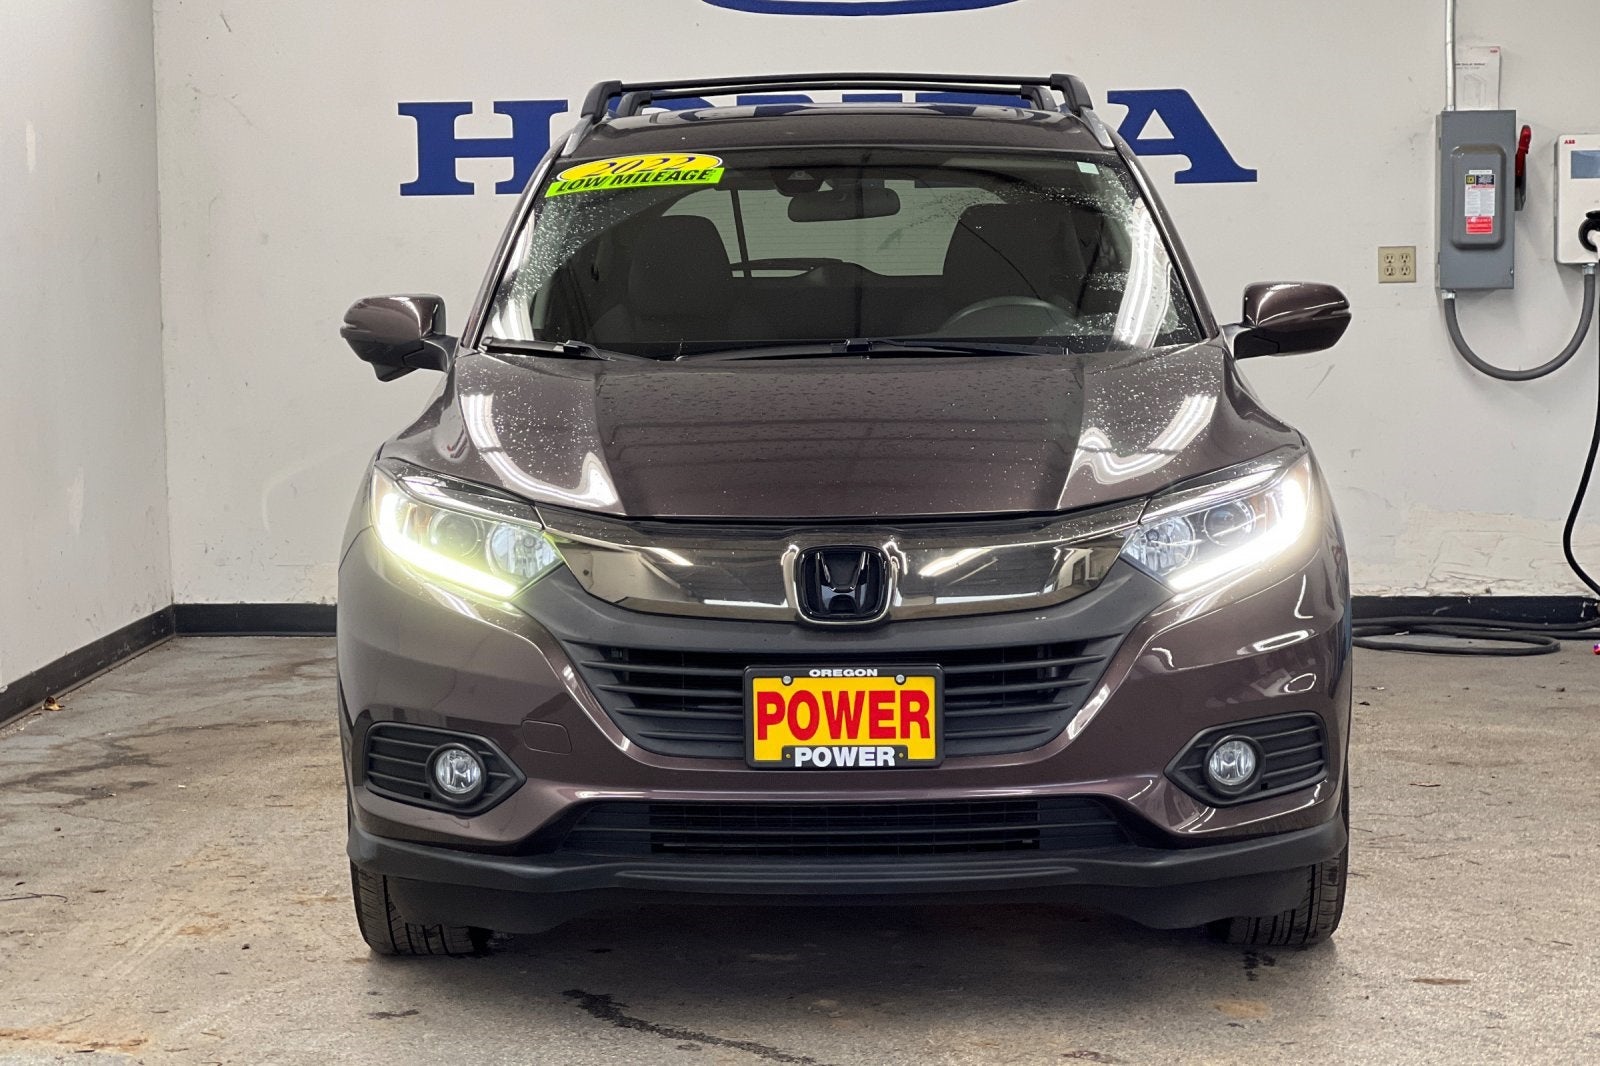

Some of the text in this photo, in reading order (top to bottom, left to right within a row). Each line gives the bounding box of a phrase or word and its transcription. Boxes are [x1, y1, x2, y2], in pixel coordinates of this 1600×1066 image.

[581, 156, 695, 178] 2022
[557, 169, 713, 192] LOW MILEAGE
[808, 668, 878, 678] OREGON
[756, 690, 931, 740] POWER
[794, 747, 896, 768] POWER
